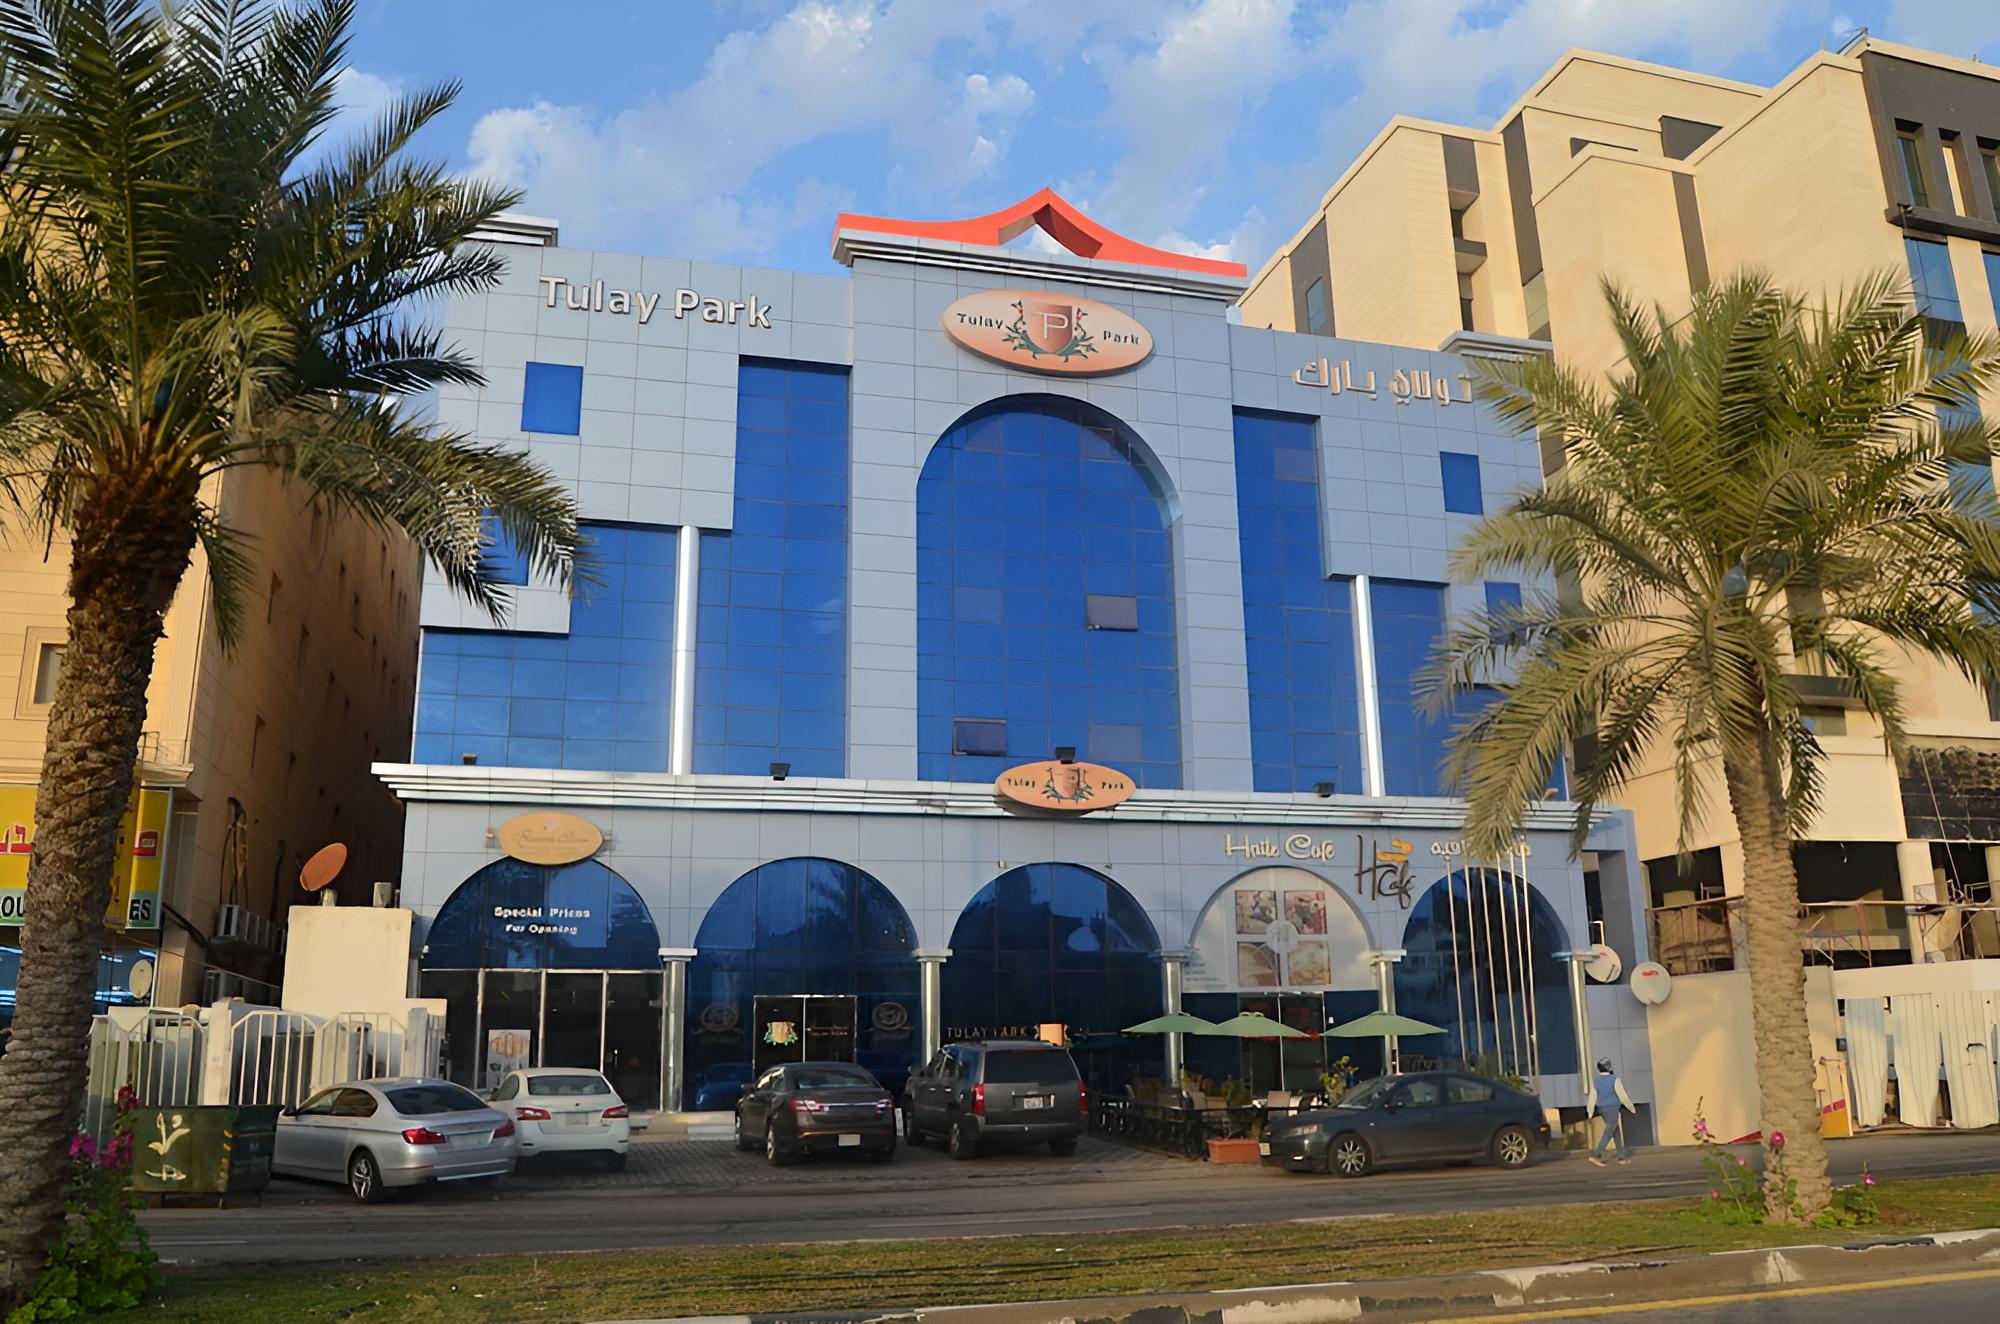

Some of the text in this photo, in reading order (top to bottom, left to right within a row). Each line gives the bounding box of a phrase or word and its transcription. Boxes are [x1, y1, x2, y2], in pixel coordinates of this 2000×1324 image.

[540, 275, 771, 329] Tulay Park
[957, 312, 1003, 329] Tulay
[1102, 330, 1139, 345] Park
[1292, 357, 1377, 400] بارك
[494, 906, 542, 919] Special
